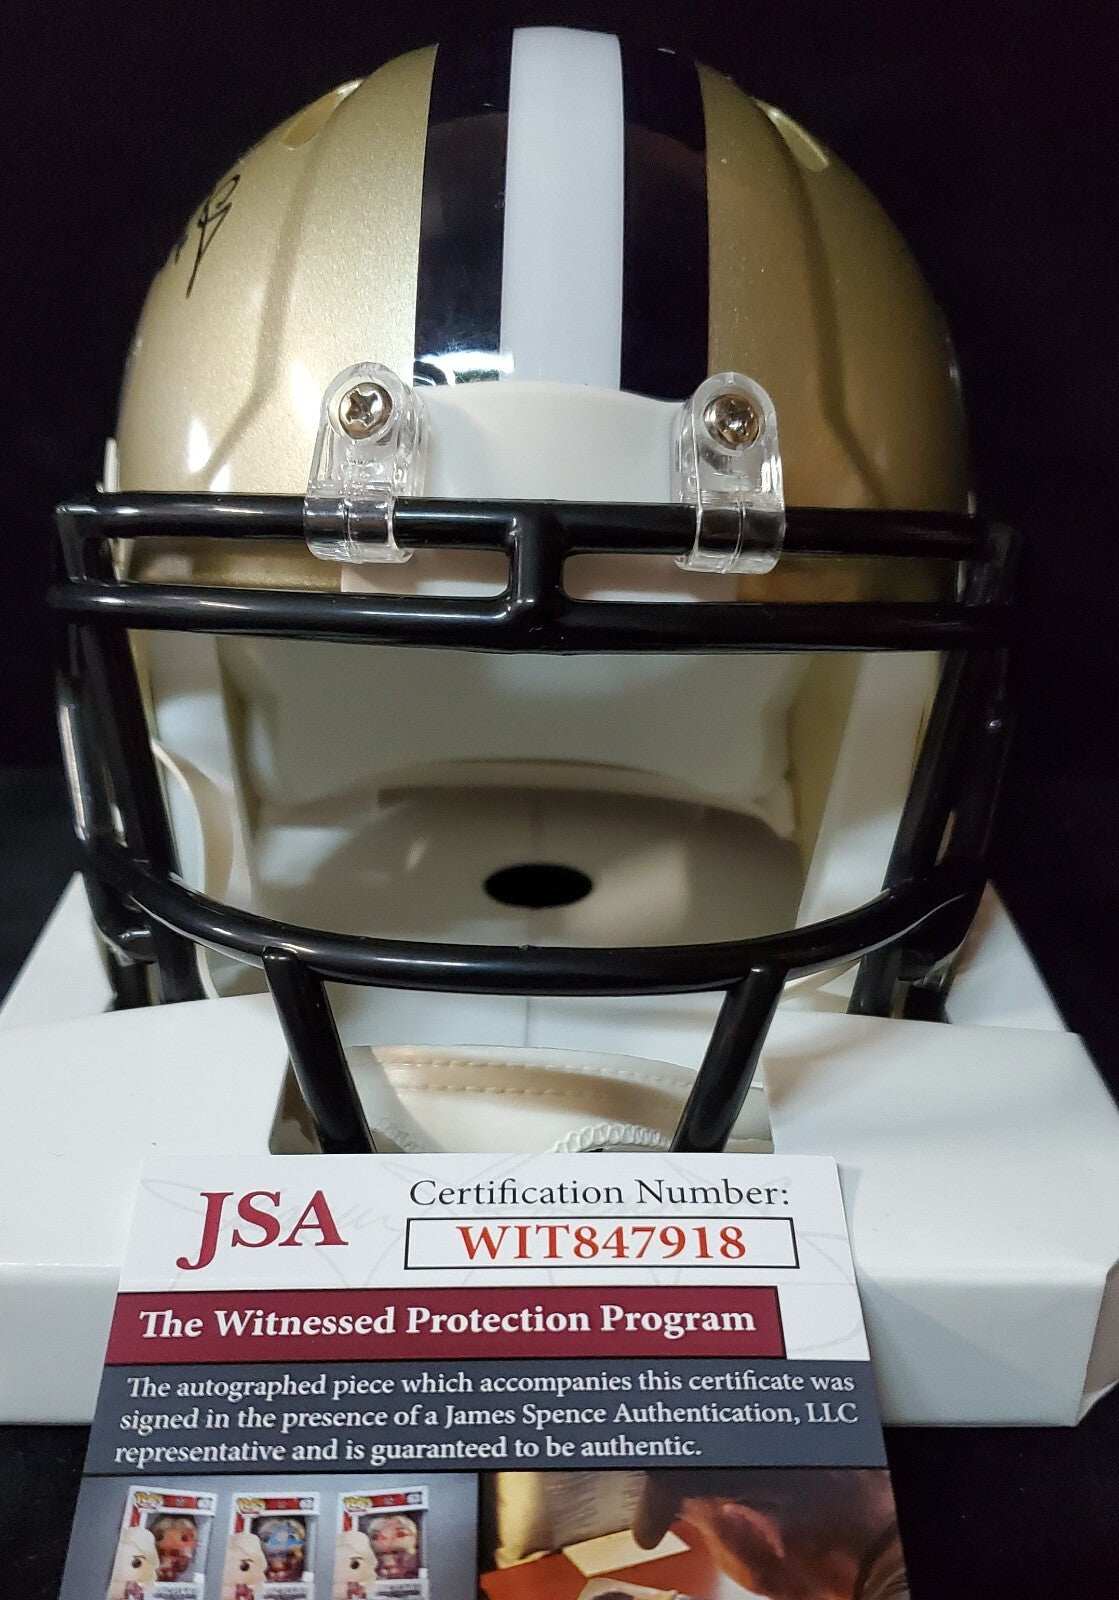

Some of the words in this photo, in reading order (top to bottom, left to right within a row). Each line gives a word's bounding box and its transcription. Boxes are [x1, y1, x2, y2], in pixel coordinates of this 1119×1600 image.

[409, 1178, 624, 1206] Certification
[634, 1177, 790, 1206] Number:
[176, 1190, 349, 1271] JSA
[456, 1224, 747, 1260] WIT847918
[139, 1308, 204, 1339] The
[213, 1305, 397, 1338] Witnessed
[405, 1304, 592, 1335] Protection
[599, 1304, 757, 1341] Program
[127, 1376, 171, 1399] The
[176, 1373, 327, 1403] autographed
[332, 1375, 395, 1402] piece
[400, 1371, 474, 1394] which
[480, 1371, 633, 1398] accompanies
[637, 1369, 683, 1392] this
[688, 1368, 805, 1392] certificate
[809, 1375, 856, 1392] was
[119, 1407, 199, 1437] signed
[205, 1408, 230, 1430] in
[237, 1406, 277, 1429] the
[280, 1411, 389, 1435] presence
[393, 1404, 423, 1427] of
[424, 1411, 439, 1426] a
[444, 1404, 516, 1430] James
[521, 1402, 607, 1431] Spence
[612, 1401, 801, 1425] Authentication,
[804, 1401, 859, 1424] LLC
[114, 1439, 286, 1470] representative
[291, 1437, 338, 1461] and
[345, 1438, 365, 1460] is
[370, 1435, 508, 1467] guaranteed
[514, 1438, 540, 1459] to
[545, 1434, 576, 1458] be
[580, 1434, 703, 1458] authentic.
